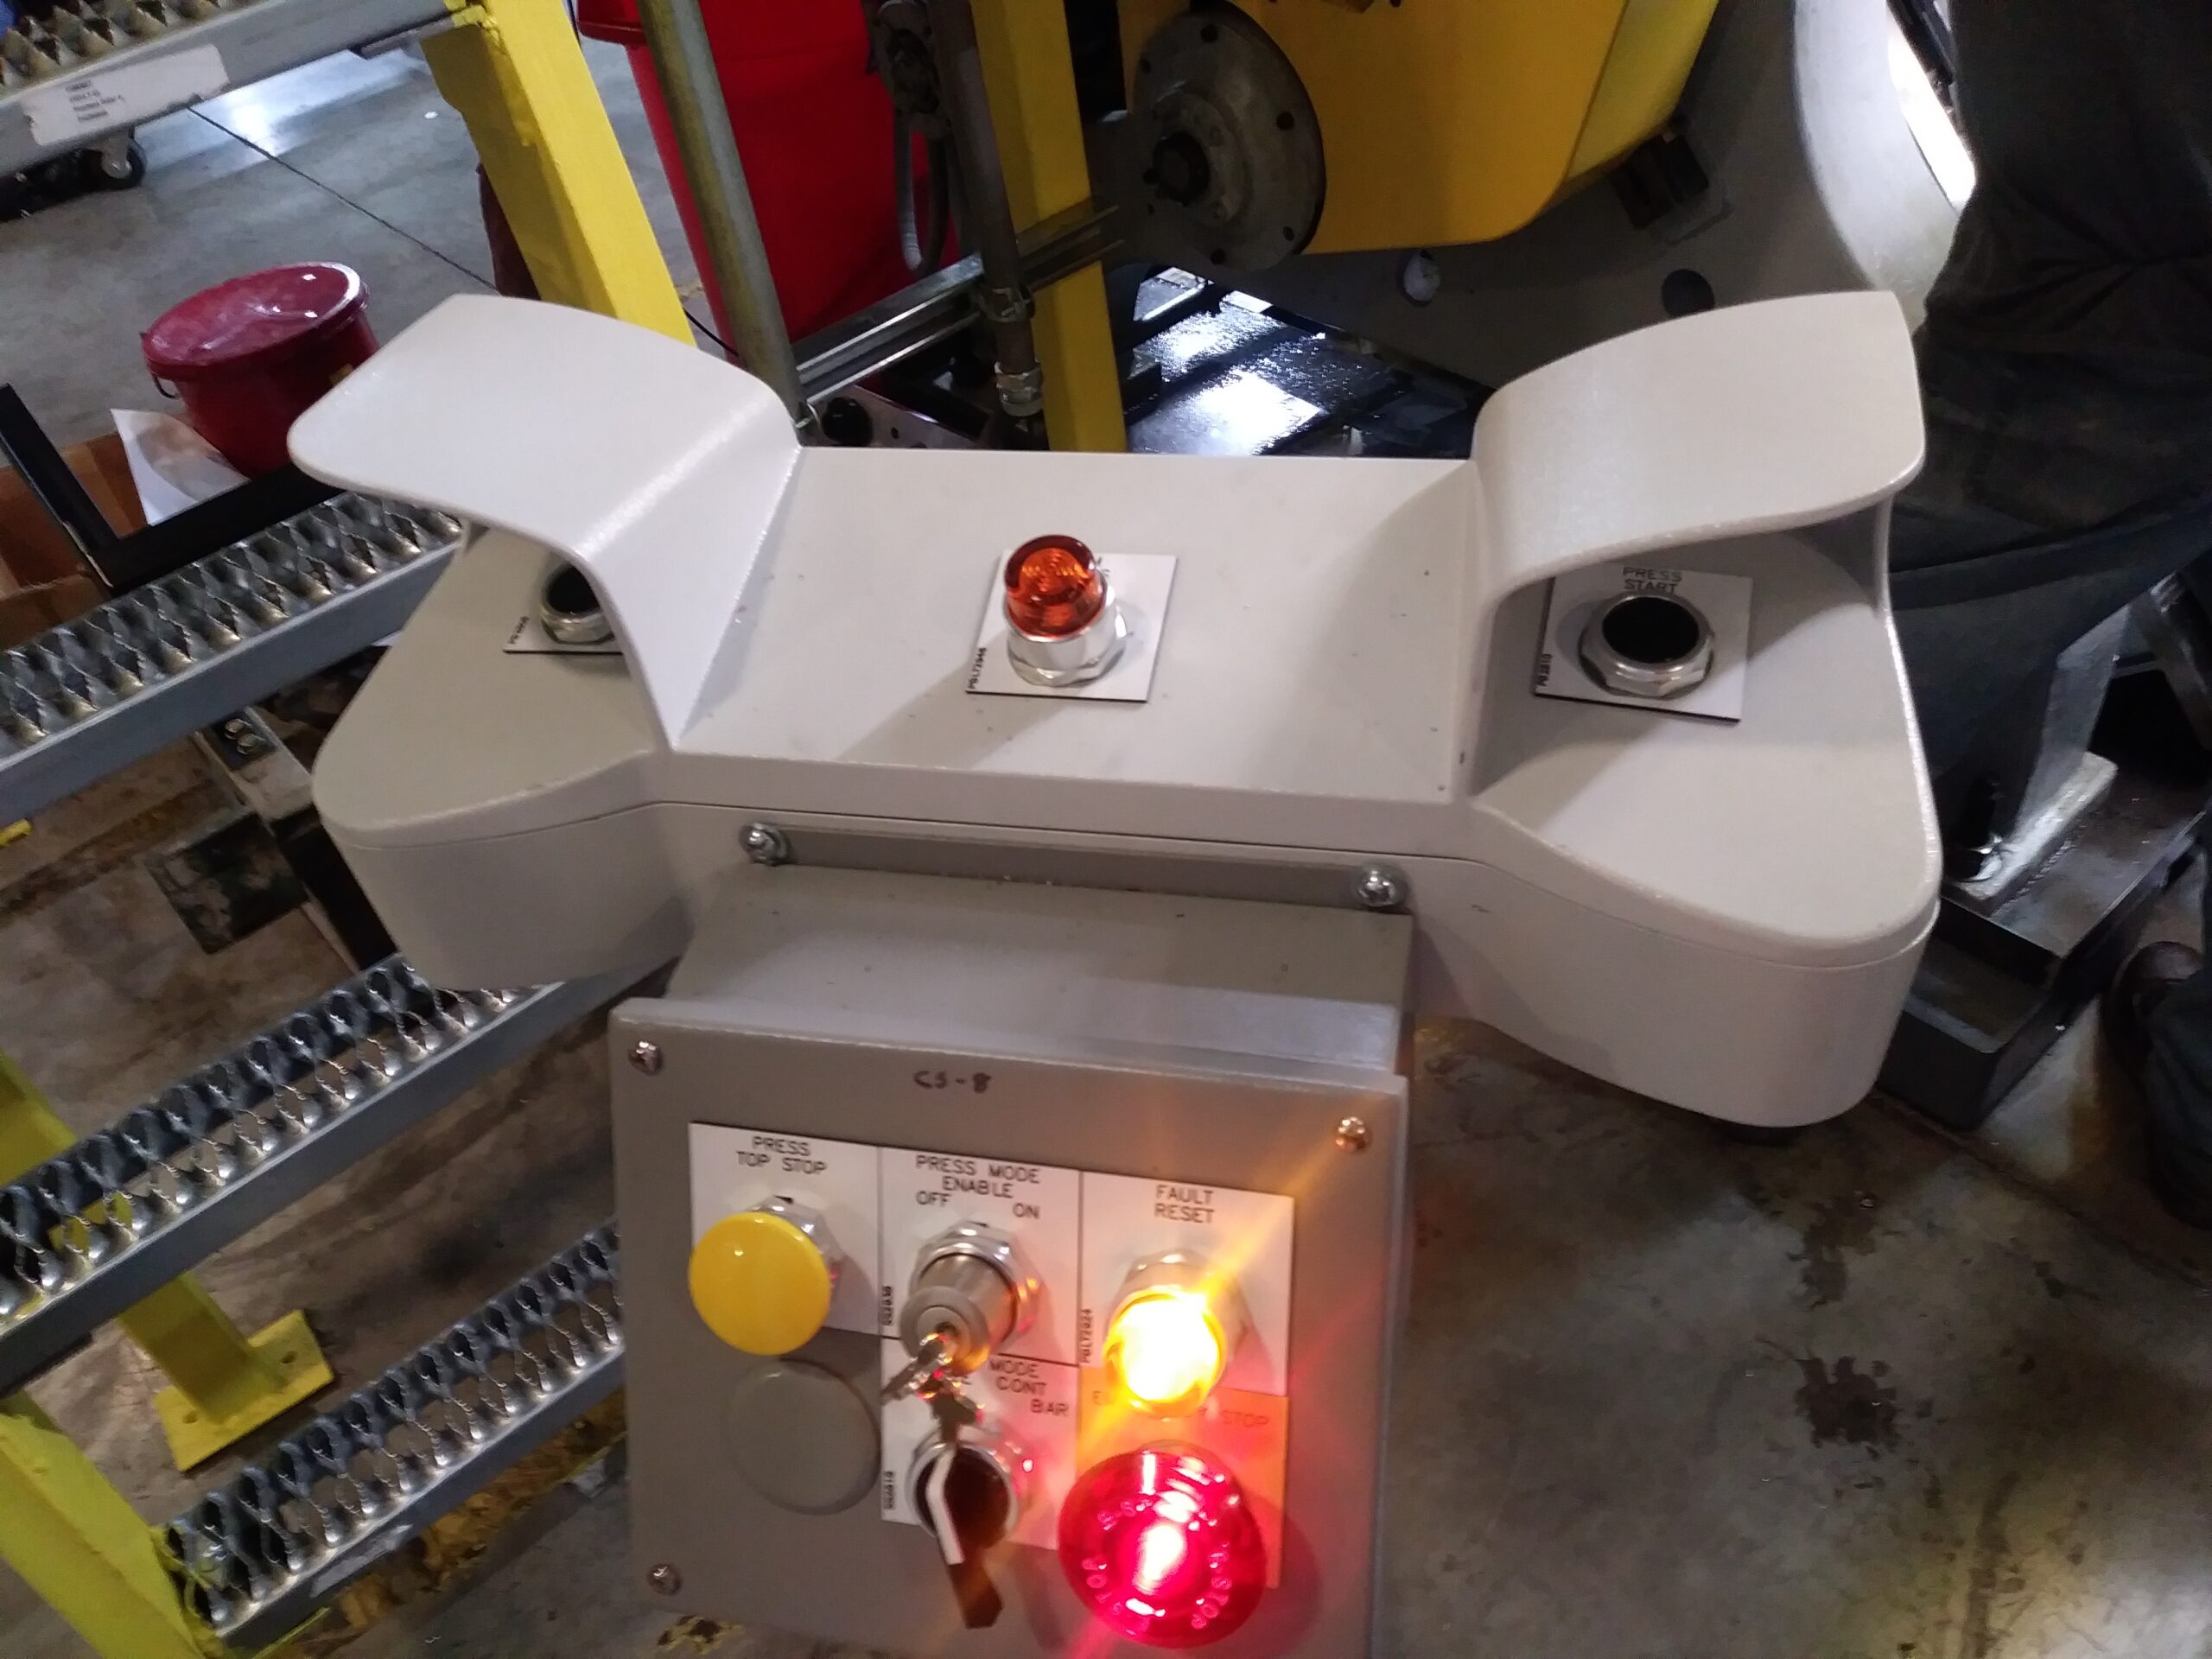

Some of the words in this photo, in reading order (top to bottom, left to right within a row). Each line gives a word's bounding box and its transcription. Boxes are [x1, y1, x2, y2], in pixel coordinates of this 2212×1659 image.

[1624, 567, 1682, 582] PRESS
[1624, 578, 1678, 594] START
[752, 1135, 810, 1157] PRESS
[736, 1150, 771, 1167] TOP
[782, 1157, 827, 1175] STOP
[916, 1155, 976, 1175] PRESS
[989, 1165, 1040, 1185] MODE
[943, 1175, 1014, 1199] ENABLE
[1155, 1184, 1214, 1205] FAULT
[916, 1190, 951, 1207] OFF
[1012, 1203, 1040, 1219] ON
[1154, 1203, 1214, 1224] RESET
[989, 1359, 1039, 1379] MODE
[995, 1376, 1047, 1395] CONT
[1030, 1398, 1070, 1417] BAR
[1223, 1409, 1269, 1427] STOP
